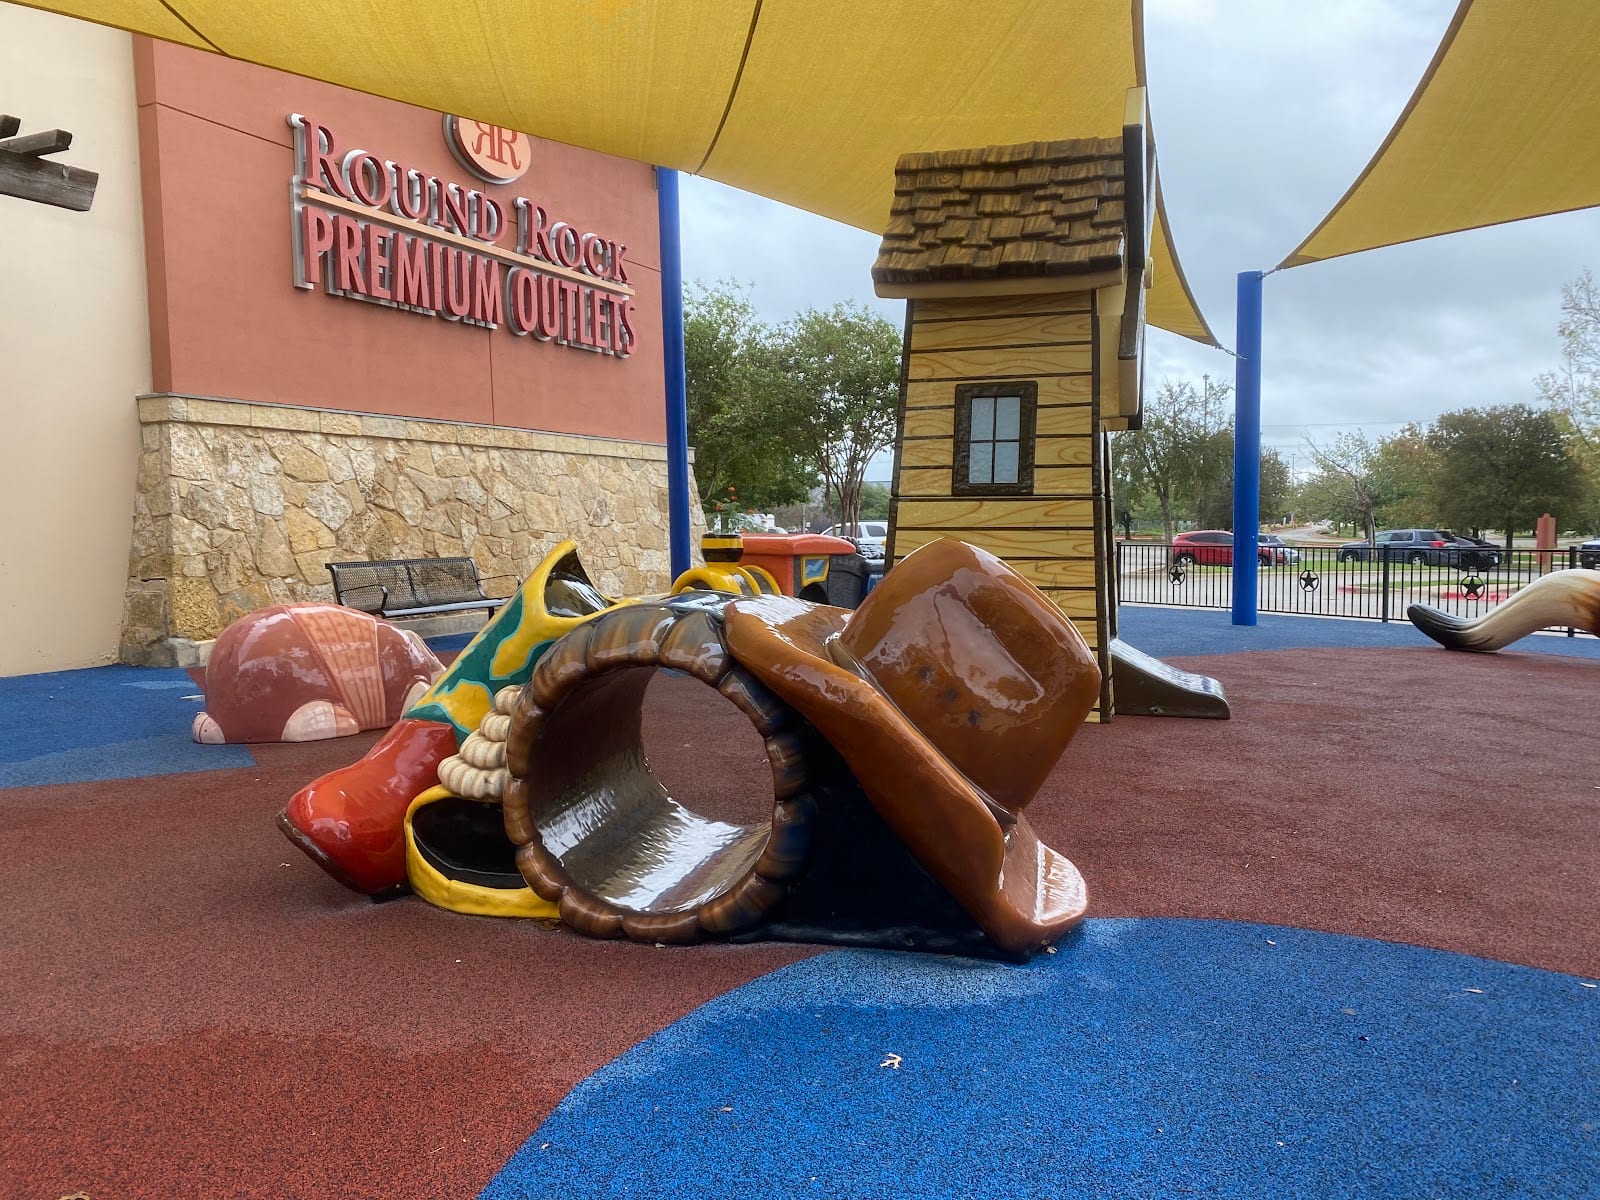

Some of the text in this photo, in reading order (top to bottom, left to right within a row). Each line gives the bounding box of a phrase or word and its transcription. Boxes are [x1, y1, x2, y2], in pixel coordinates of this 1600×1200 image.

[297, 115, 633, 285] ROUND ROCK
[300, 206, 638, 356] PREMIUM OUTLETS
